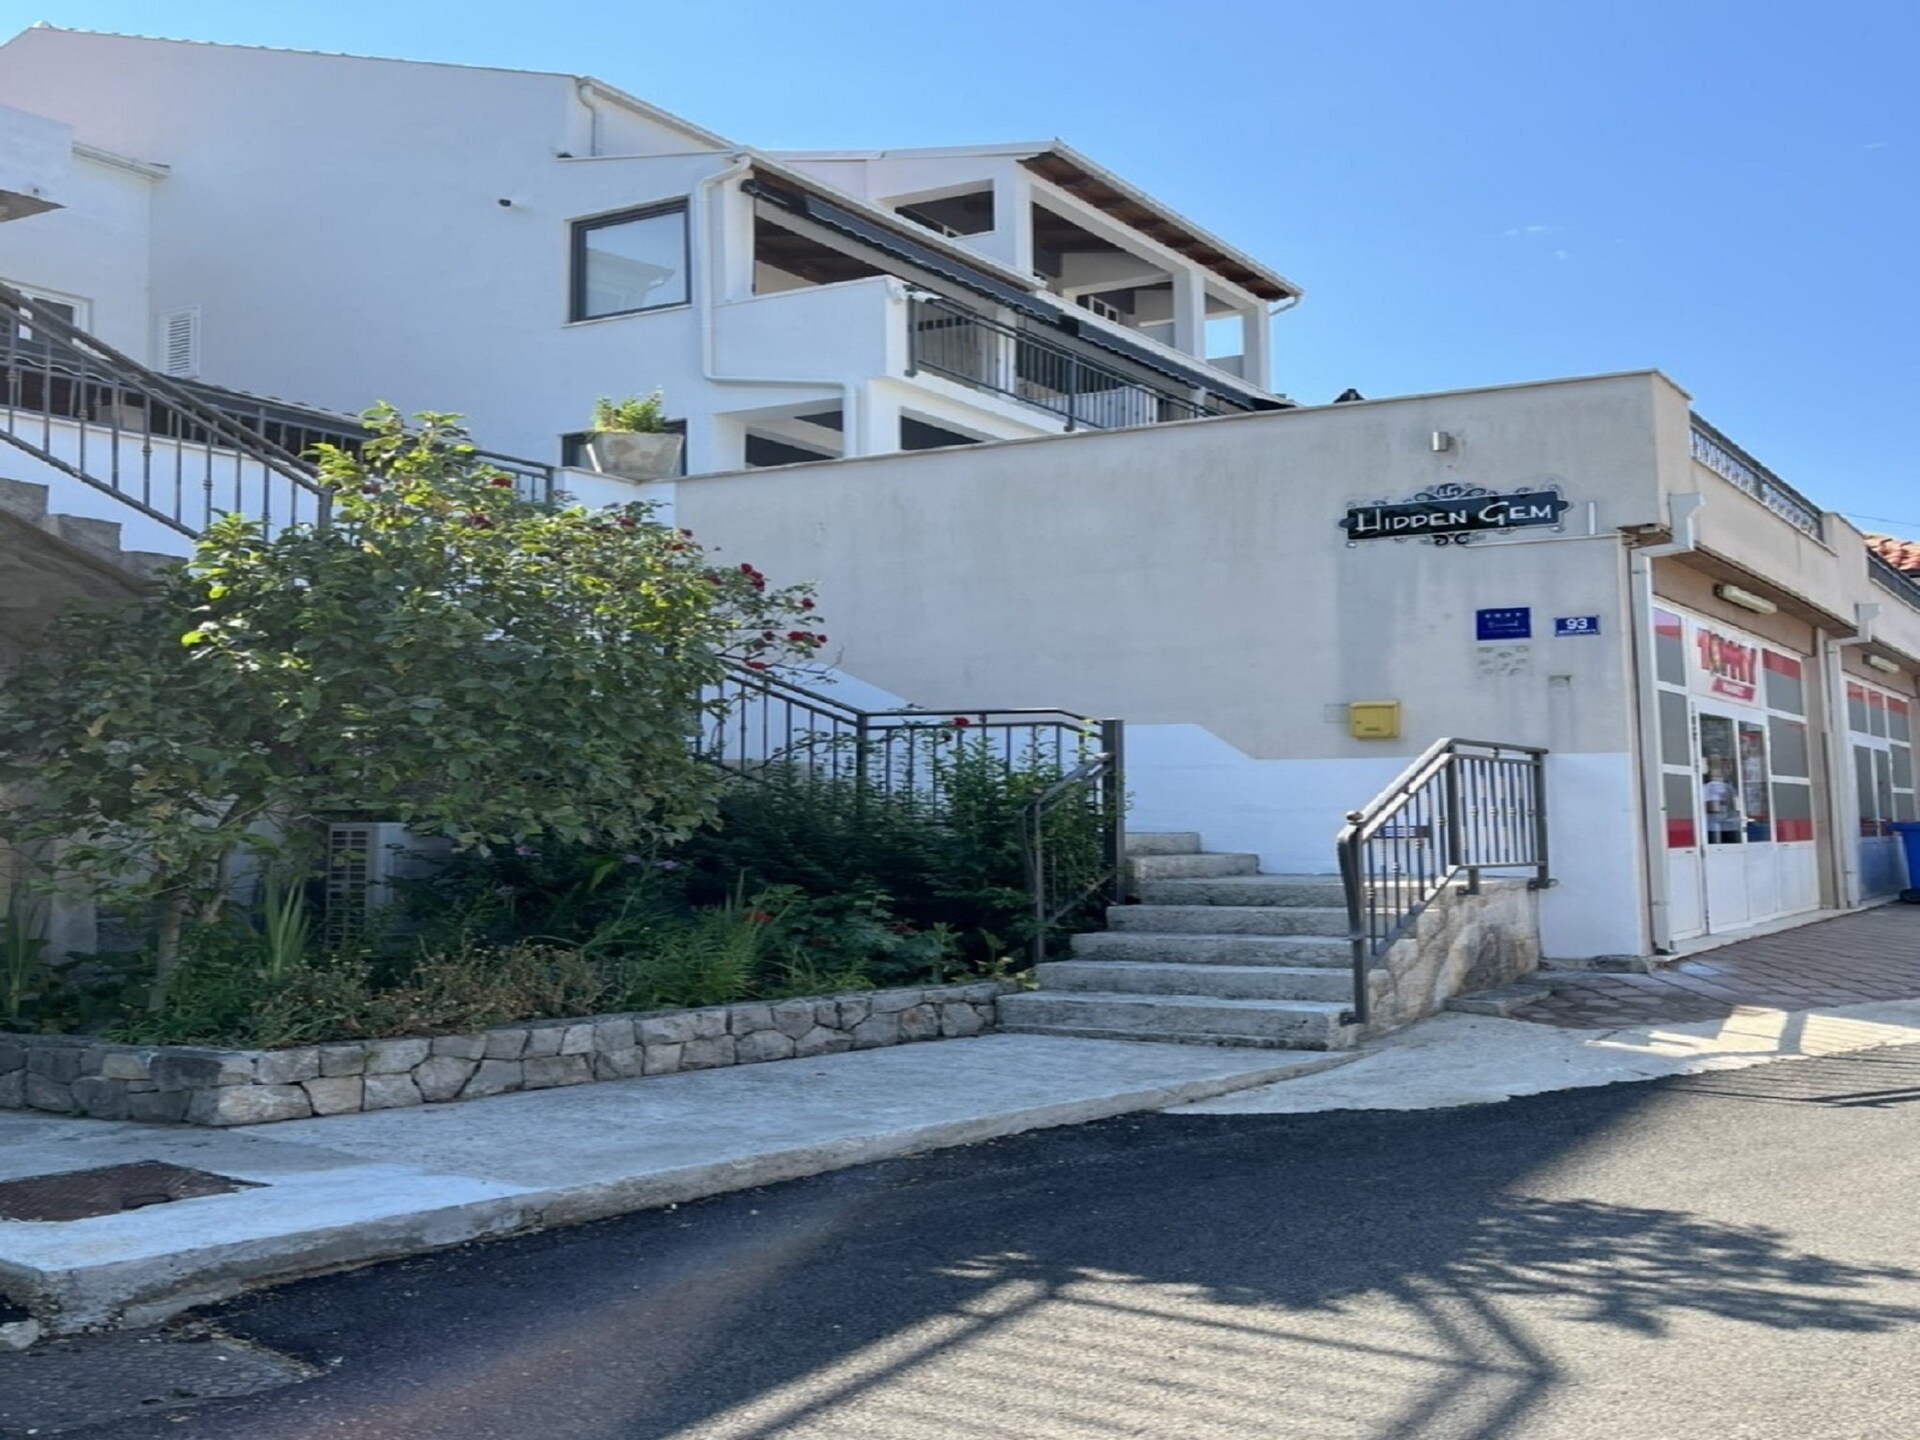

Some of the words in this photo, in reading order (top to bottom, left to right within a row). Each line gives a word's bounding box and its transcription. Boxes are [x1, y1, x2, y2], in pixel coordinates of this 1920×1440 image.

[1356, 508, 1467, 532] HIDDEN
[1478, 501, 1551, 525] GEM
[1566, 618, 1588, 630] 93
